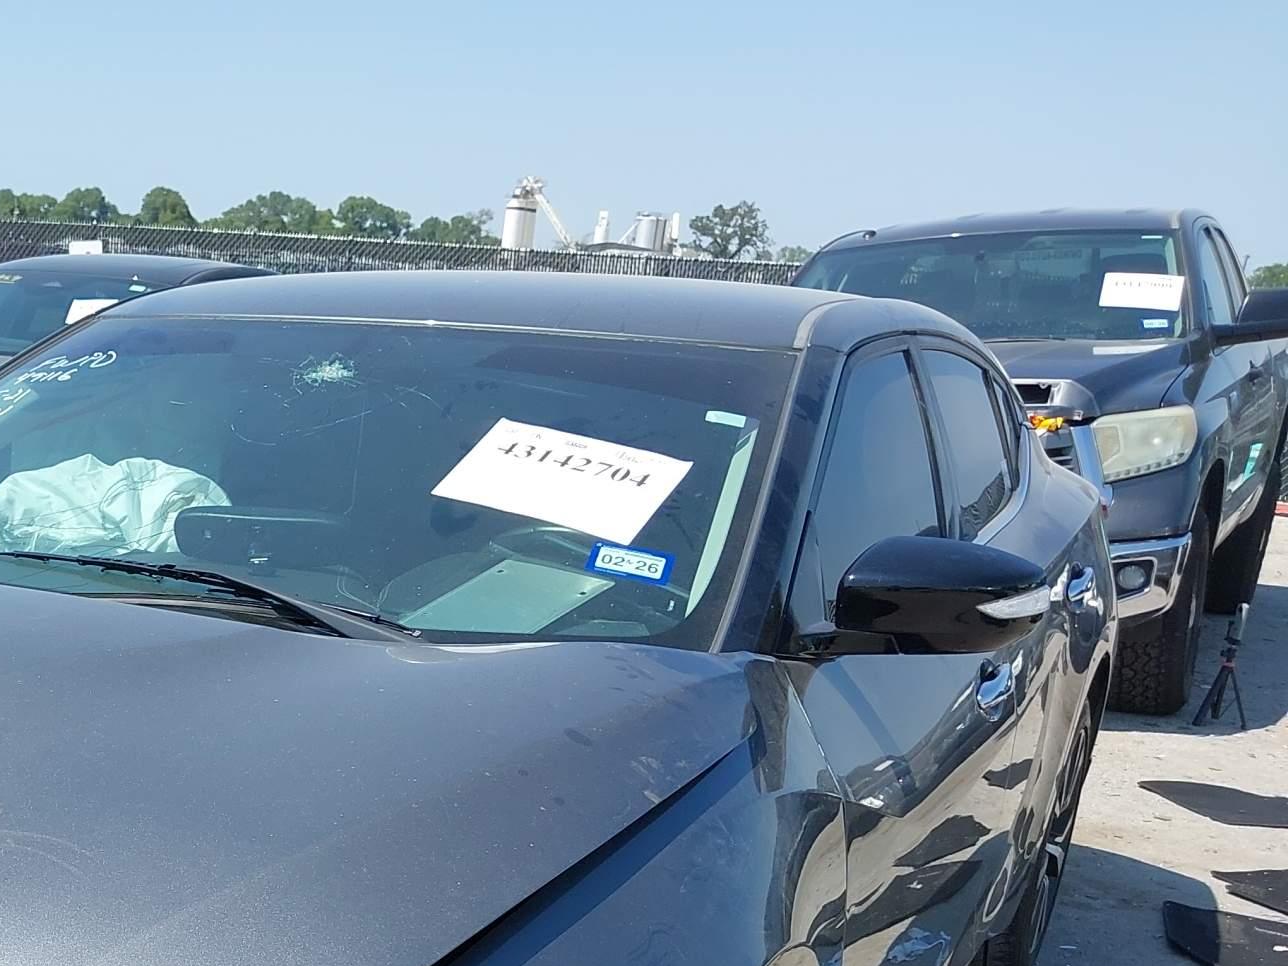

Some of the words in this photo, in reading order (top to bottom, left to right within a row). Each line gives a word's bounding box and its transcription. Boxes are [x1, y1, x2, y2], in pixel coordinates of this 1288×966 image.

[497, 442, 651, 487] 43142704
[600, 554, 626, 567] 02
[634, 560, 660, 574] 26
